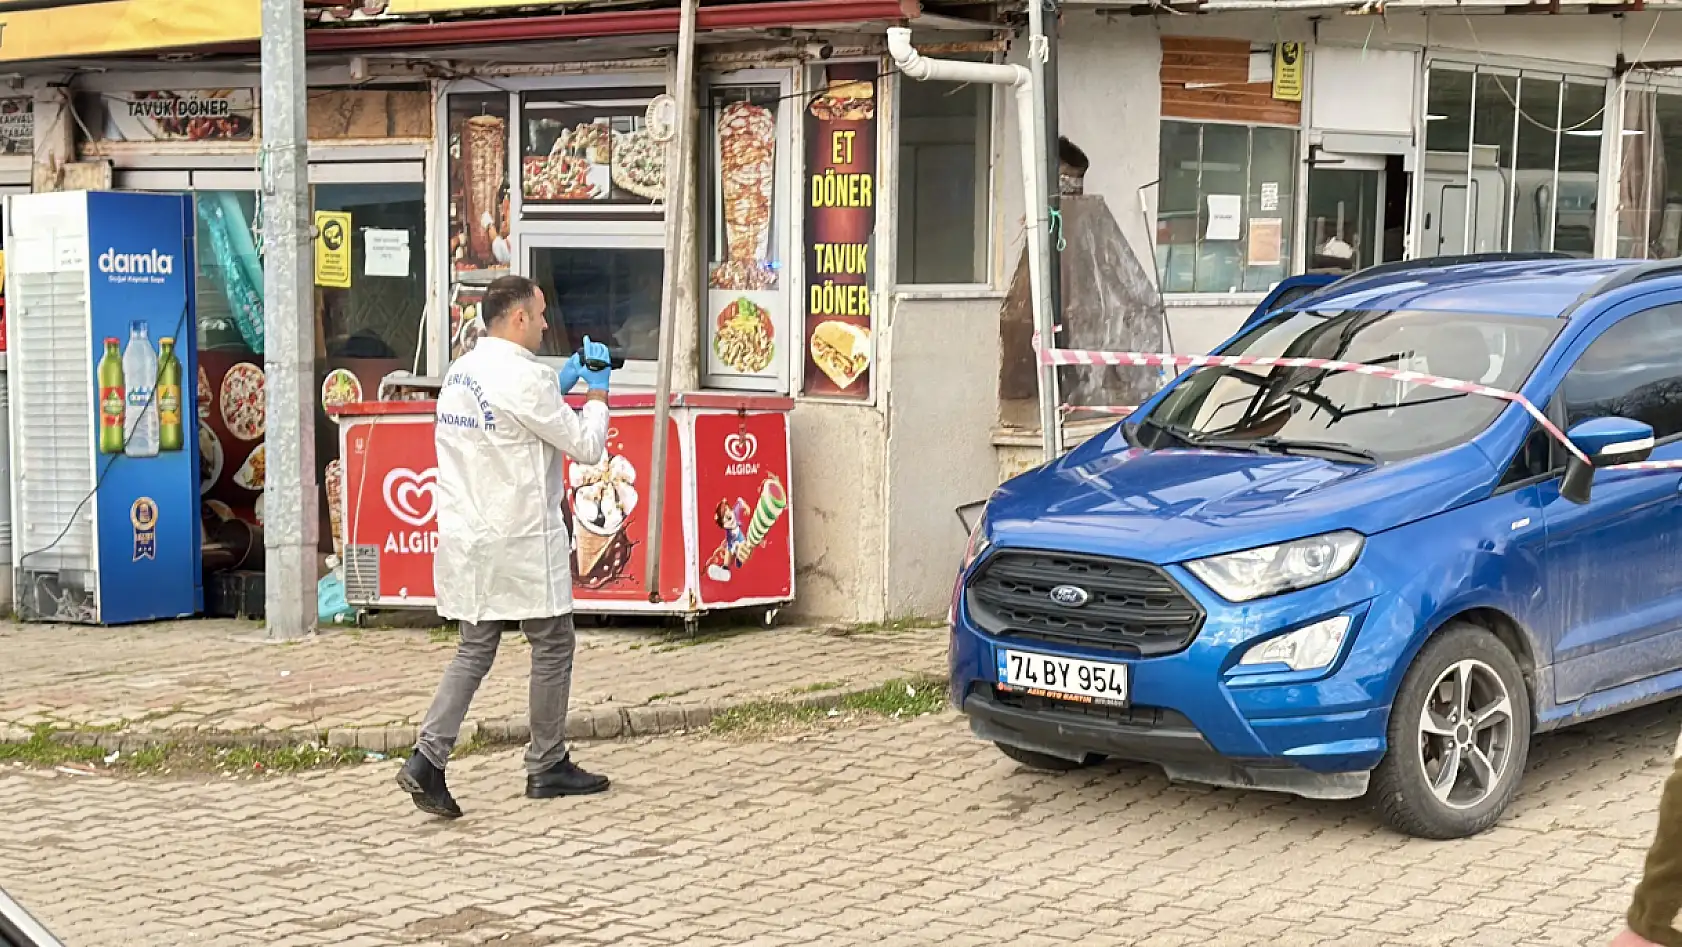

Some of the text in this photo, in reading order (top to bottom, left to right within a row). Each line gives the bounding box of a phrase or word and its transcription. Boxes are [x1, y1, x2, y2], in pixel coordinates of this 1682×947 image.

[127, 95, 229, 117] TAVUK DÖNER
[832, 131, 856, 164] ET
[811, 168, 873, 207] DÖNER
[98, 247, 173, 274] damla
[814, 243, 868, 274] TAVUK
[810, 280, 870, 316] DÖNER
[1011, 655, 1122, 695] 74 BY 954
